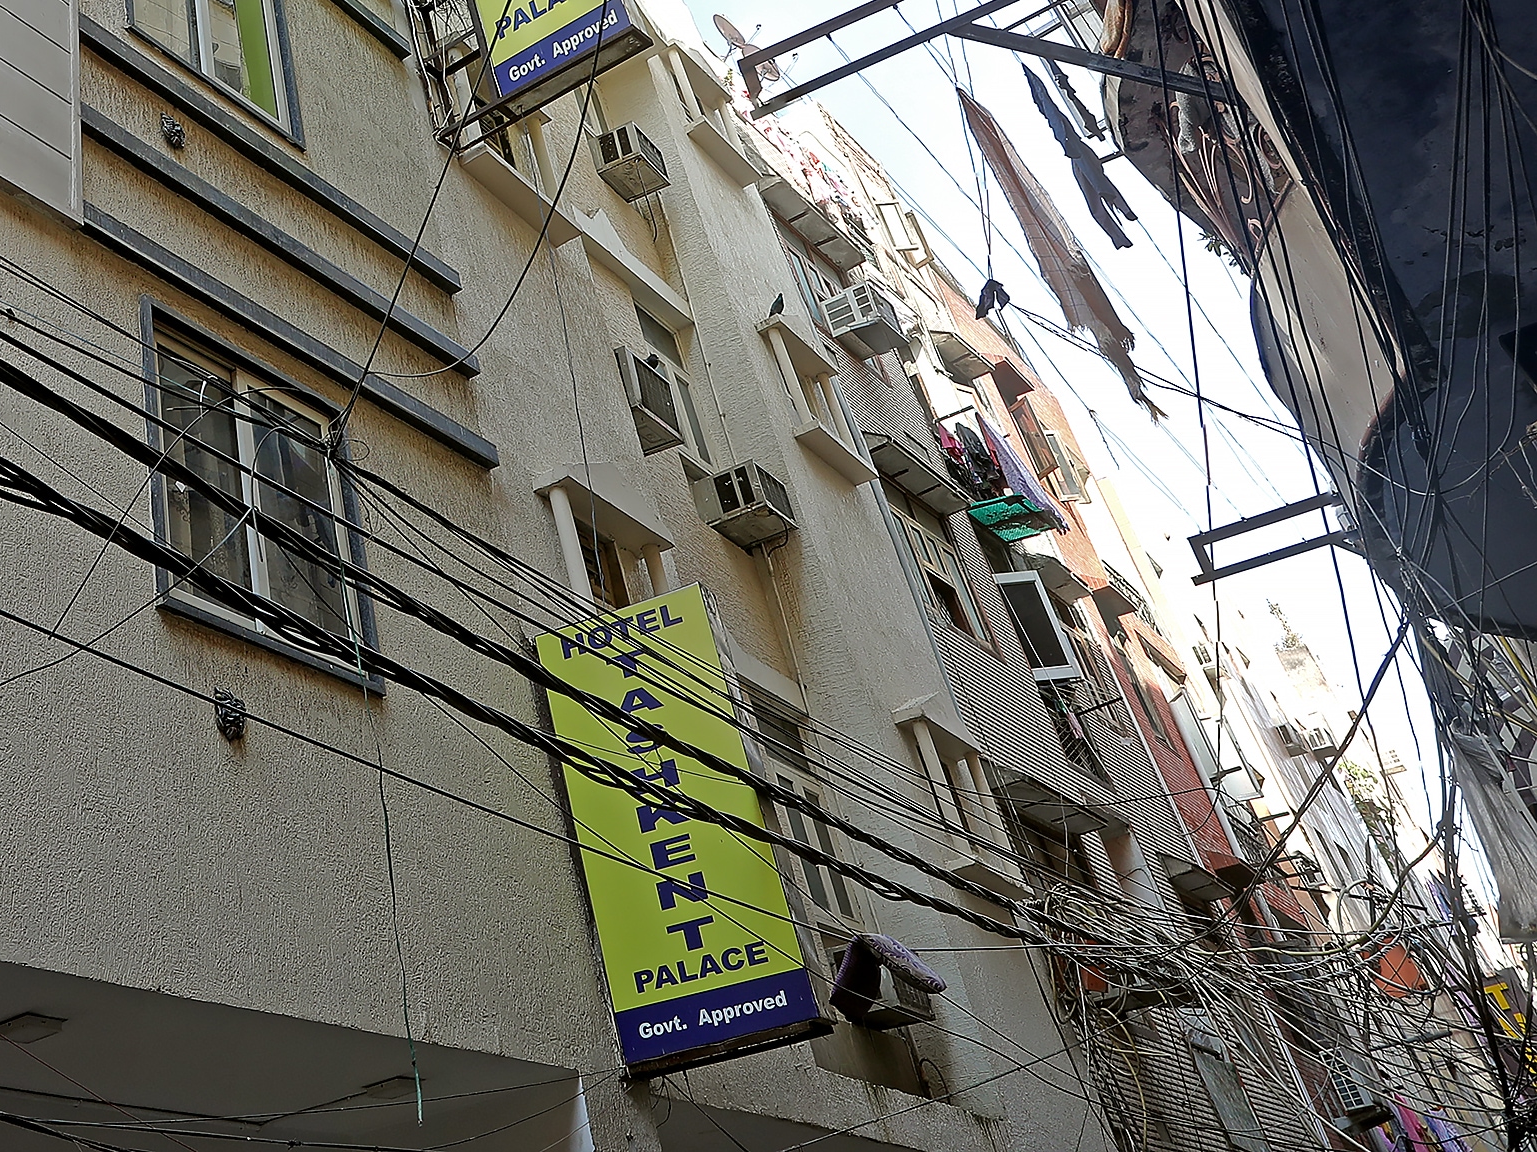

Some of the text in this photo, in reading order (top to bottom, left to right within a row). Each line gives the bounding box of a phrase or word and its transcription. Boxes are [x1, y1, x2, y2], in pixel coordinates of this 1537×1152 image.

[508, 9, 618, 82] Govt. Approved
[561, 605, 683, 660] HOTEL
[606, 649, 714, 952] TASHKENT
[633, 940, 769, 994] PALACE
[638, 989, 788, 1040] Govt. Approved
